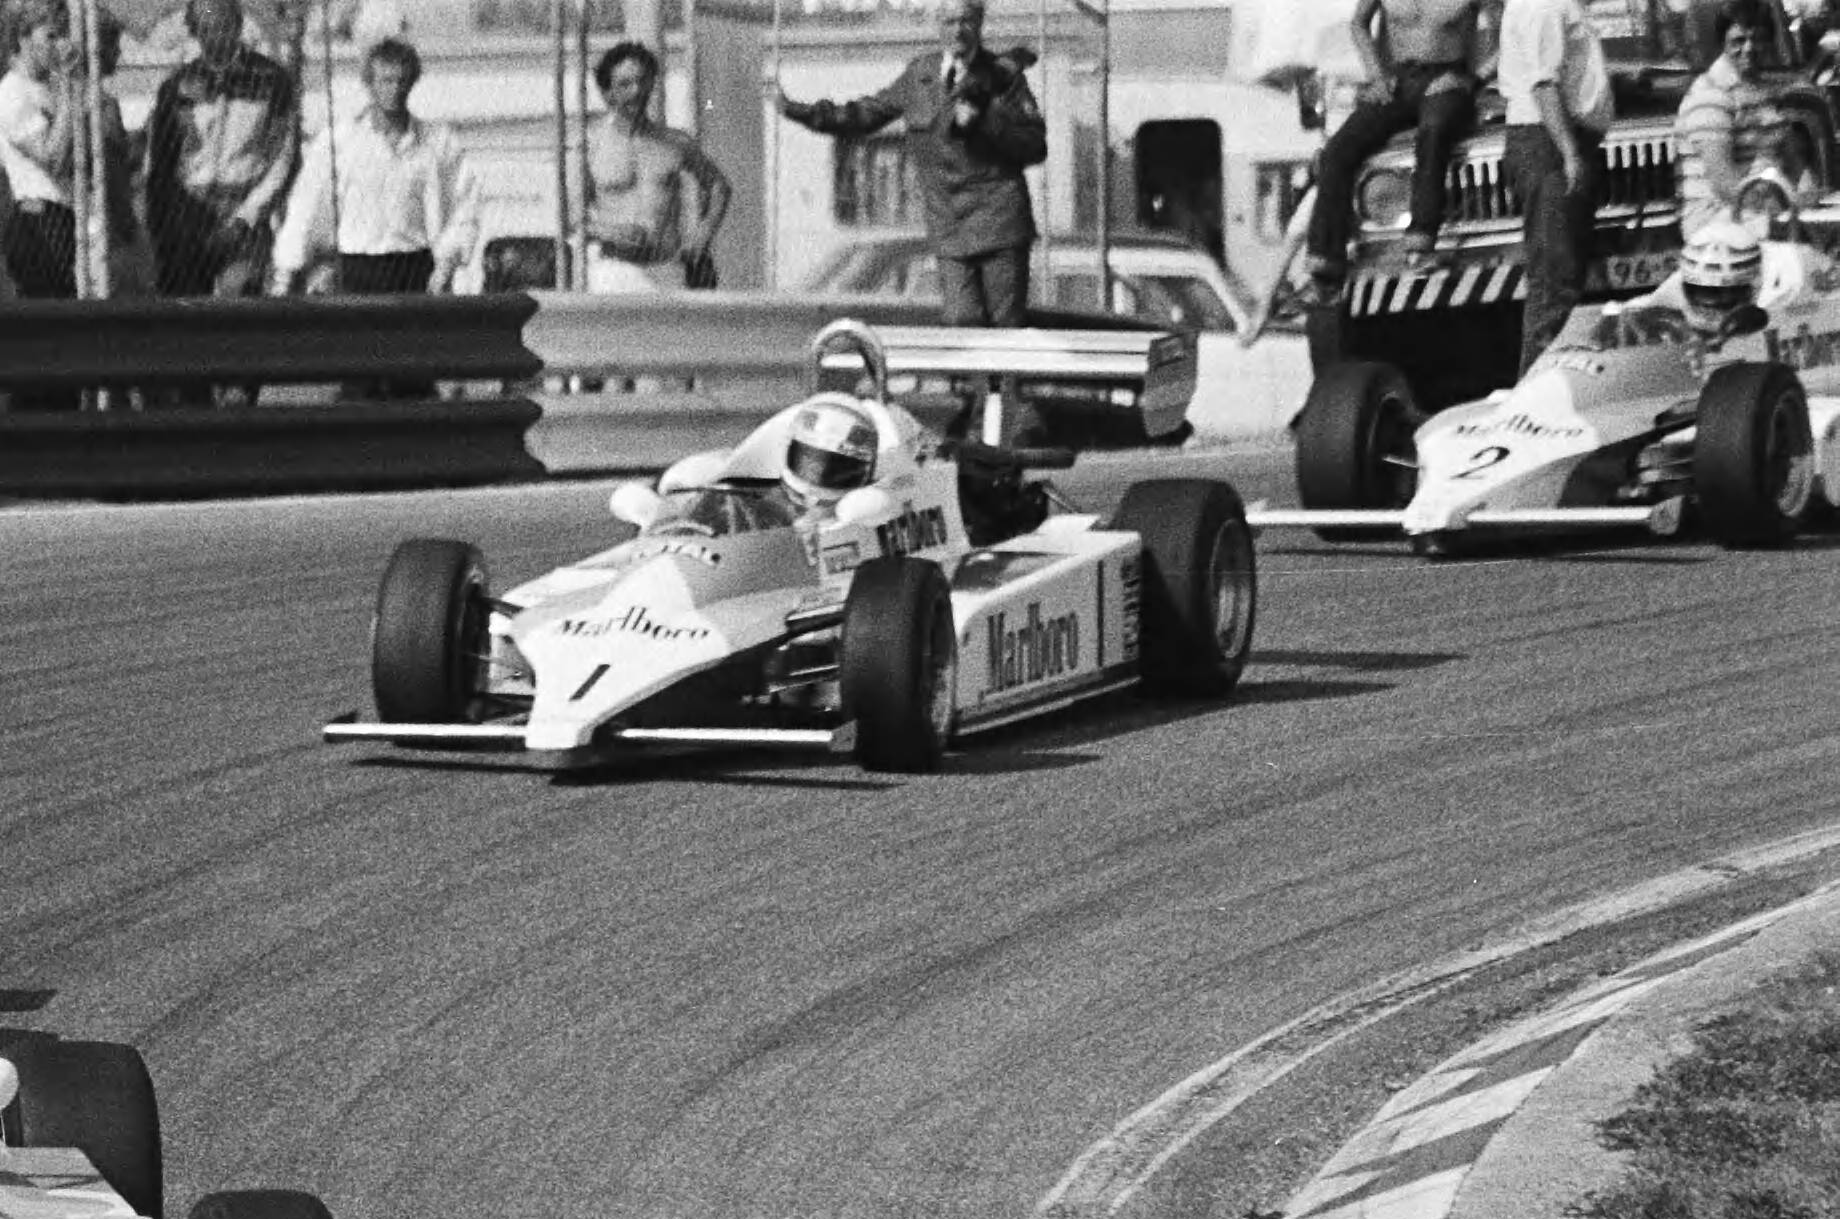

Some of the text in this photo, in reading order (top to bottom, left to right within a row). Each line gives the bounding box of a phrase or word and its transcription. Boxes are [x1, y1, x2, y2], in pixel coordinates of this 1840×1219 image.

[1456, 414, 1584, 437] Marlboro
[1450, 446, 1511, 480] 2
[561, 606, 712, 638] Marlboro
[986, 601, 1079, 692] Marlboro
[568, 663, 611, 702] 1
